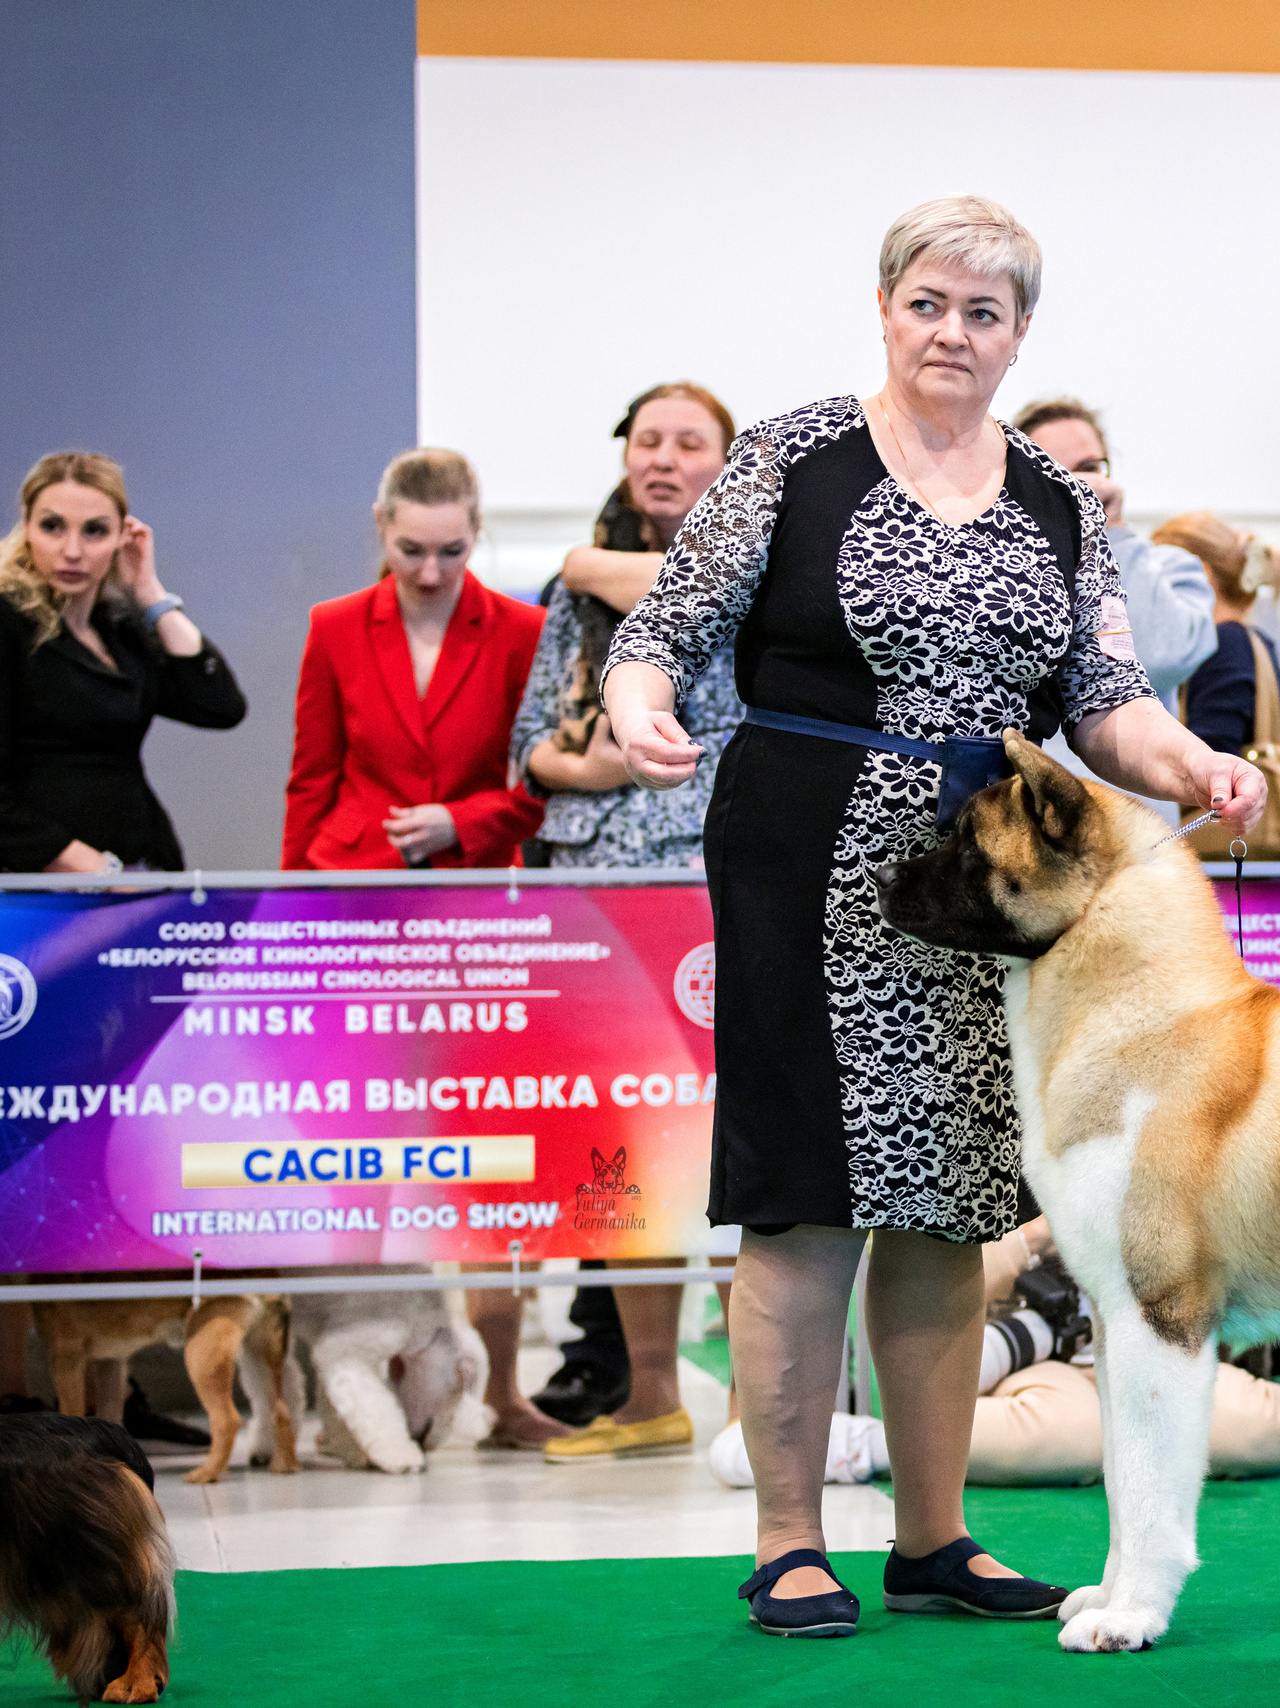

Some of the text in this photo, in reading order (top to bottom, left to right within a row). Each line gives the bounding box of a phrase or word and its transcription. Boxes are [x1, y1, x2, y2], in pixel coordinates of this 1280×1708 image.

[159, 914, 552, 942] СОЮЗ ОБЩЕСТВЕННЫХ ОБЪЕДИНЕНИЙ
[98, 941, 611, 967] «БЕЛОРУССКОЕ КИНОЛОГИЧЕСКОЕ ОБЪЕДИНЕНИЕ»
[182, 967, 529, 991] BELORUSSIAN CINOLOGICAL UNION
[183, 1002, 528, 1035] MINSK BELARUS
[0, 1080, 350, 1123] ЖДУНАРОДНАЯ
[365, 1074, 599, 1112] ВЫСТАВКА
[243, 1144, 471, 1183] CACIB FCI
[152, 1202, 559, 1236] INTERNATIONAL DOG SHOW
